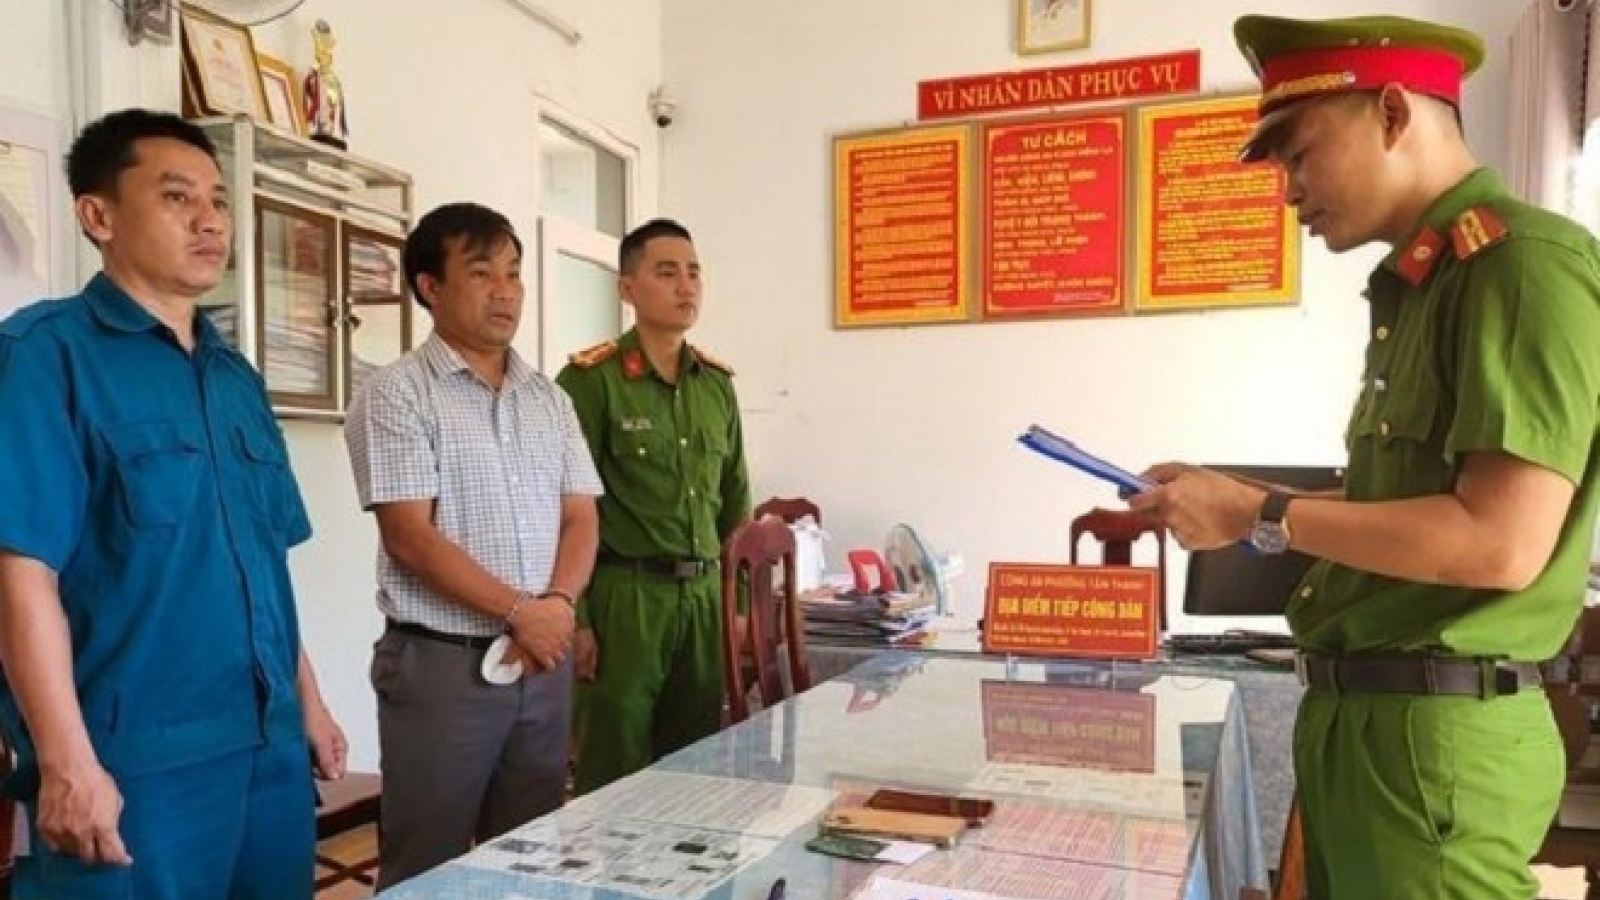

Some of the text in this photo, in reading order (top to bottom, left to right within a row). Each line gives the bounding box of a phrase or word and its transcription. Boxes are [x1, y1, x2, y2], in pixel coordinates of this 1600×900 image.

[960, 77, 1022, 108] NHÂN
[1028, 71, 1073, 101] DÂN
[1080, 66, 1142, 98] PHỤC
[1150, 62, 1180, 92] VỤ
